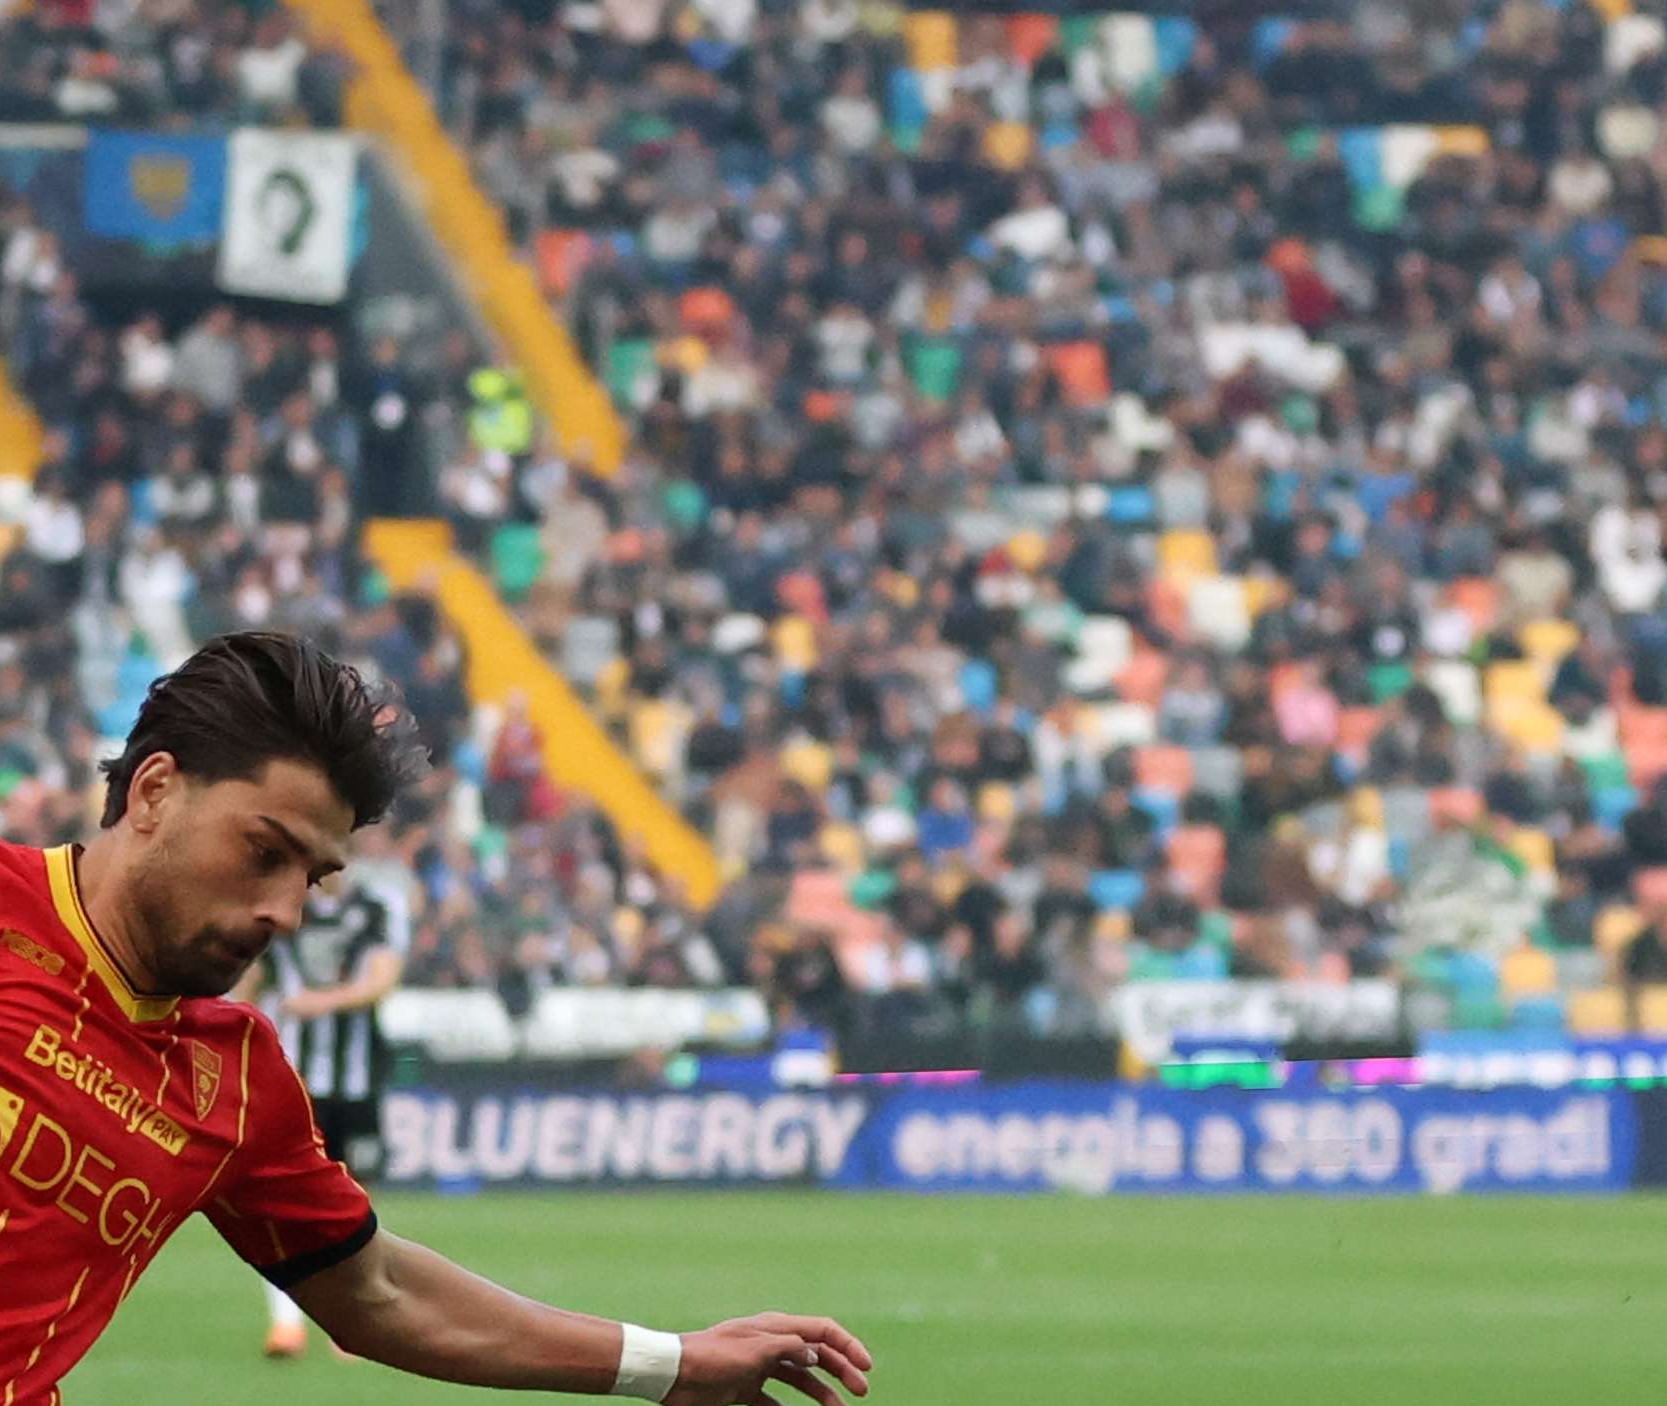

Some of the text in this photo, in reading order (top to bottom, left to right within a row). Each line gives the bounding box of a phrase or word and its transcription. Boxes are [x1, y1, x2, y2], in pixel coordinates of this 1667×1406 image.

[24, 1024, 156, 1133] Betitaly
[150, 1119, 186, 1145] PAY
[380, 1092, 1613, 1195] BLUENERGY energia a 360 gradi
